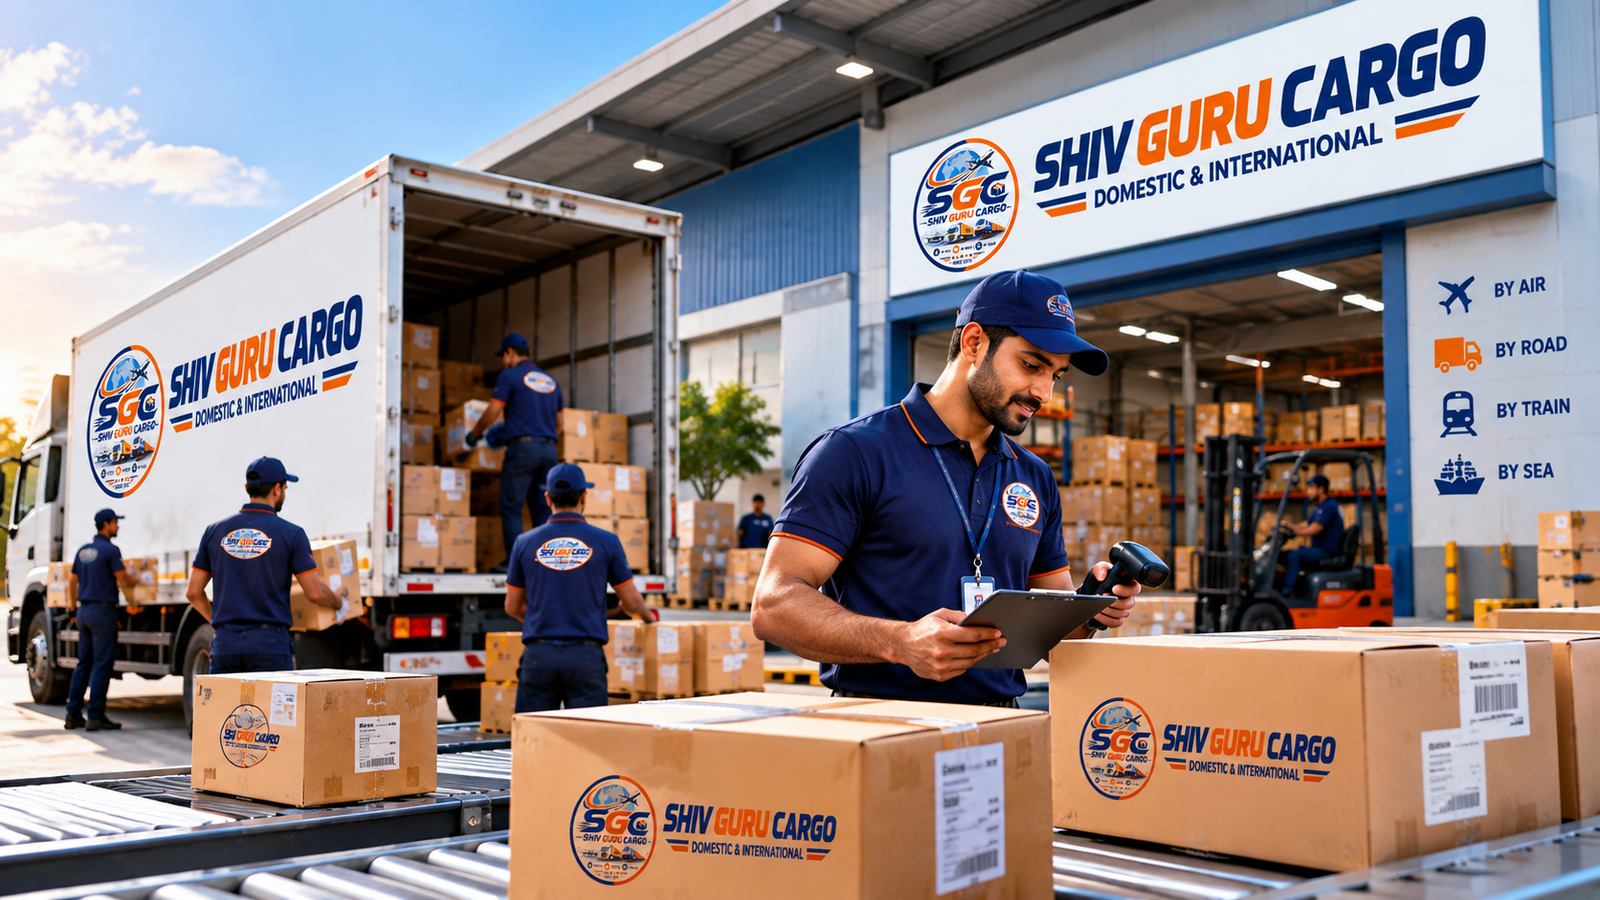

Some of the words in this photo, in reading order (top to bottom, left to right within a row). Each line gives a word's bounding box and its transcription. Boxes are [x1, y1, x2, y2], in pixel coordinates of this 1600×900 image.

[1033, 118, 1135, 194] SHIV
[1136, 77, 1273, 167] GURU
[1280, 15, 1487, 129] CARGO
[1094, 168, 1185, 208] DOMESTIC
[1189, 165, 1204, 186] &
[1209, 123, 1383, 183] INTERNATIONAL
[922, 170, 1010, 218] SGC
[927, 214, 948, 226] SHIV
[948, 209, 975, 223] GURU
[975, 203, 1007, 218] CARGO
[1494, 280, 1515, 298] BY
[1518, 276, 1546, 295] AIR
[168, 352, 217, 410] SHIV
[215, 327, 277, 394] GURU
[277, 294, 364, 373] CARGO
[1495, 341, 1516, 358] BY
[1521, 336, 1568, 356] ROAD
[94, 383, 160, 433] SGC
[195, 400, 235, 428] DOMESTIC
[236, 398, 243, 416] &
[244, 375, 318, 414] INTERNATIONAL
[1497, 402, 1518, 419] BY
[1522, 398, 1571, 417] TRAIN
[1498, 463, 1519, 480] BY
[1523, 462, 1555, 479] SEA
[1088, 728, 1152, 755] SGC
[1161, 723, 1211, 754] SHIV
[1209, 727, 1266, 759] GURU
[1266, 731, 1337, 765] CARGO
[1188, 759, 1228, 775] DOMESTIC
[1229, 763, 1236, 775] &
[1237, 764, 1301, 782] INTERNATIONAL
[579, 809, 652, 836] SGC
[662, 802, 714, 835] SHIV
[713, 806, 771, 838] GURU
[772, 811, 838, 843] CARGO
[623, 836, 648, 845] CARGO
[691, 841, 733, 856] DOMESTIC
[734, 843, 741, 856] &
[742, 844, 804, 860] INTERNATIONAL
